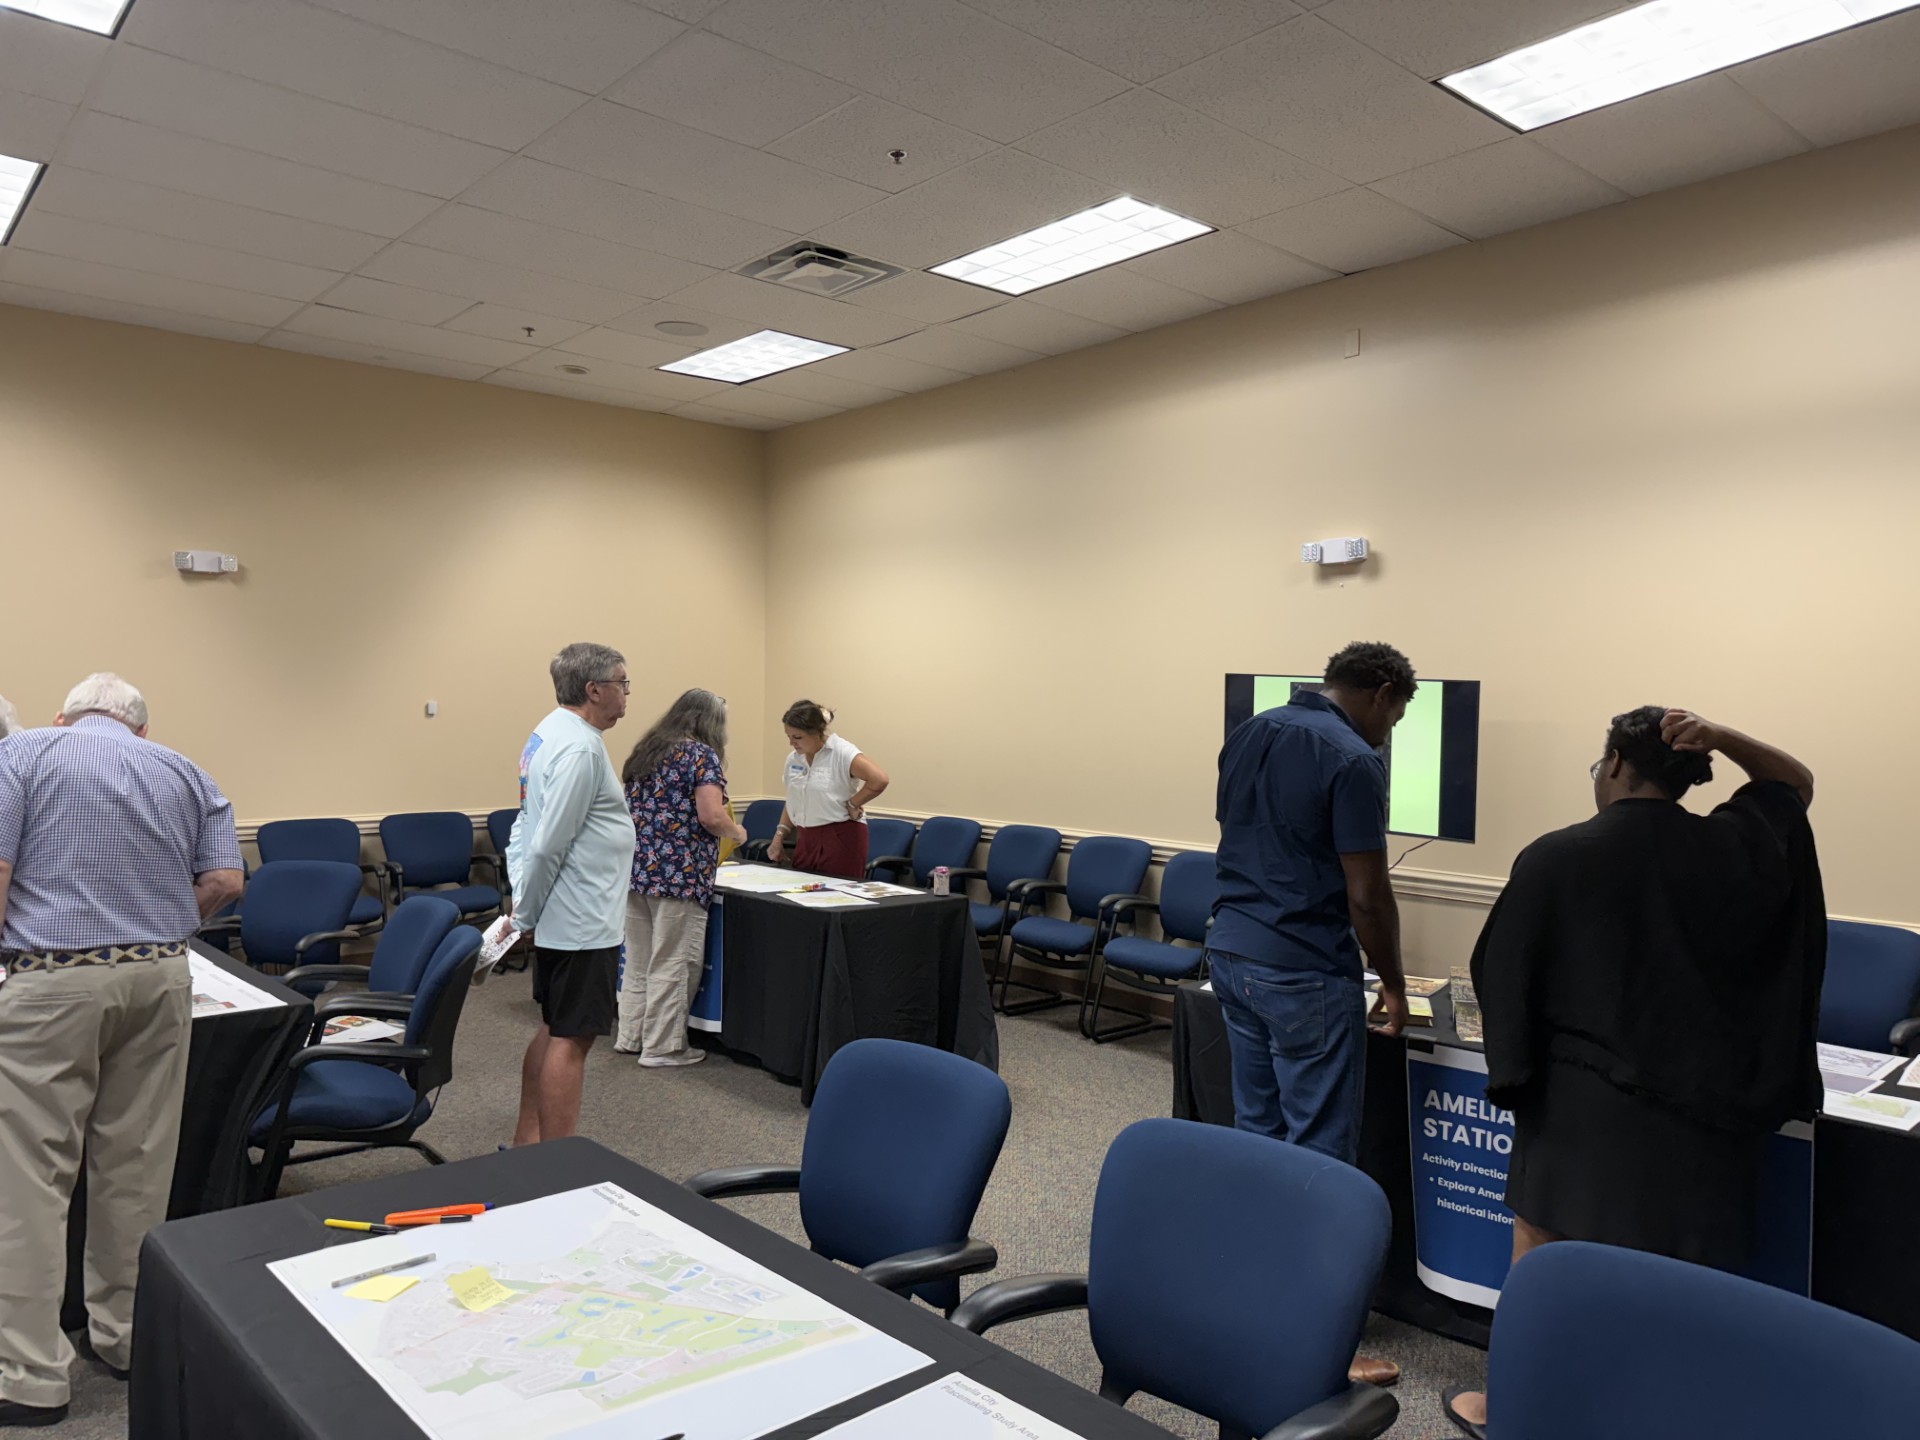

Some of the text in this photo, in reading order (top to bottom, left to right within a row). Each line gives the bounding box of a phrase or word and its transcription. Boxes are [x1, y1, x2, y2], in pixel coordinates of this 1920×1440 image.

[1423, 1089, 1515, 1127] AMELIA
[1423, 1117, 1513, 1155] STATIO
[1422, 1152, 1461, 1171] Activity
[1437, 1176, 1505, 1202] Explore Amel
[1436, 1197, 1515, 1225] historical infor
[940, 1384, 1039, 1440] Placemaking Study Area
[981, 1394, 999, 1406] City
